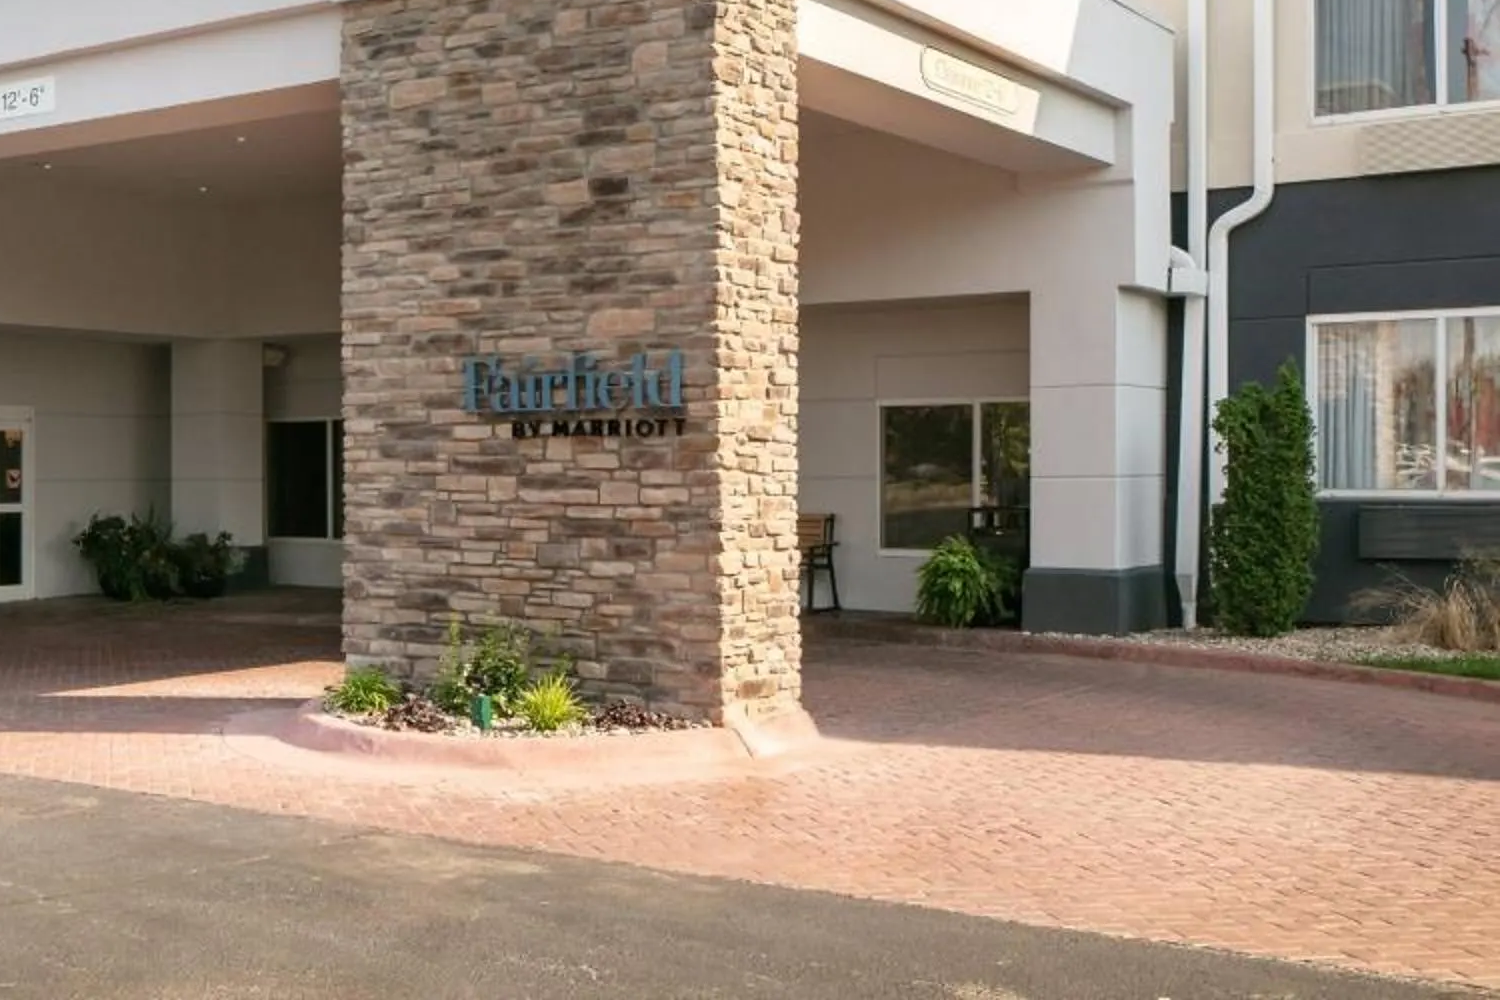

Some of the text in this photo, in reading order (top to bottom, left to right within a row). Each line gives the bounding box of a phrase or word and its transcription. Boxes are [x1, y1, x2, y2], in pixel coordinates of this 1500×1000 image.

[463, 346, 685, 413] Fairfield
[512, 417, 686, 439] BY MARRIOTT
